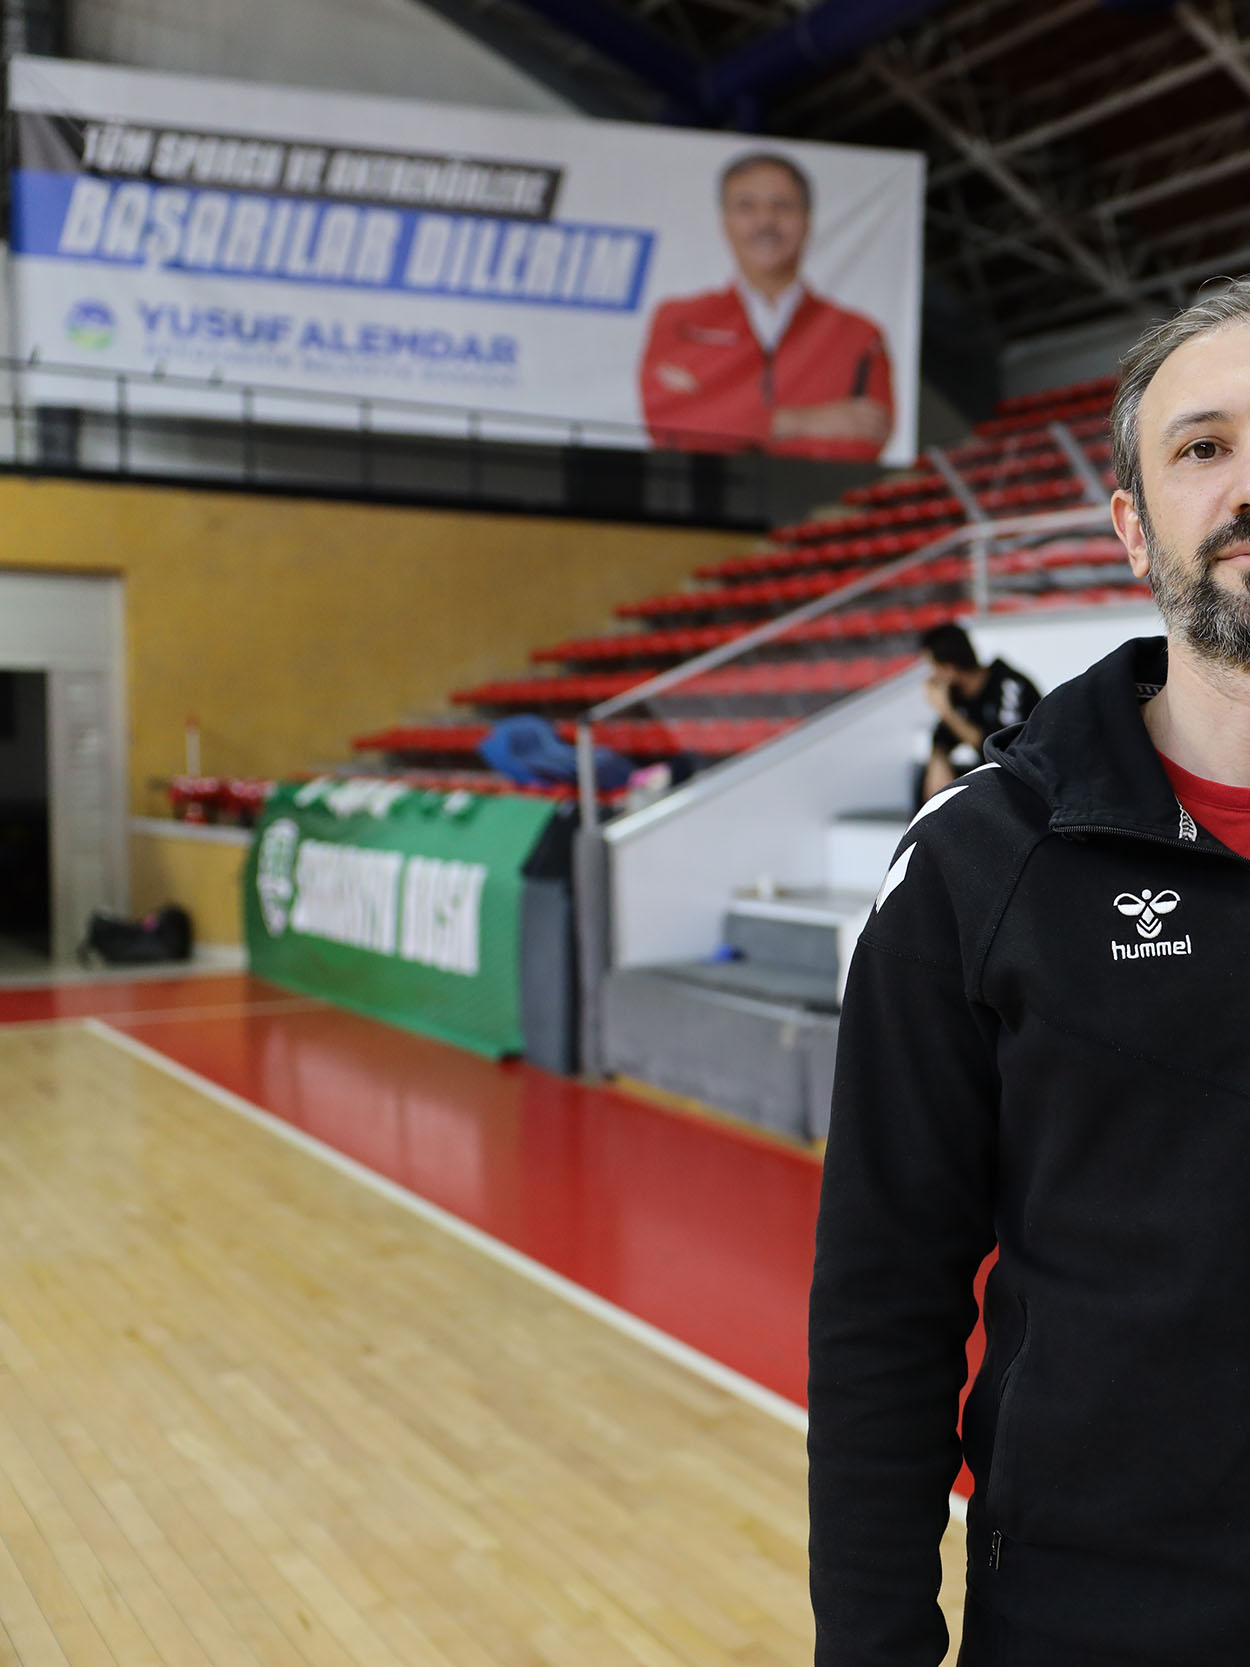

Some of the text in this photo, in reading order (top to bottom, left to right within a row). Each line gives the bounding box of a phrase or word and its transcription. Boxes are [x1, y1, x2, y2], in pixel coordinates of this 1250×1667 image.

[138, 299, 521, 364] YUSUF ALEMDAR
[1111, 934, 1192, 961] hummel
